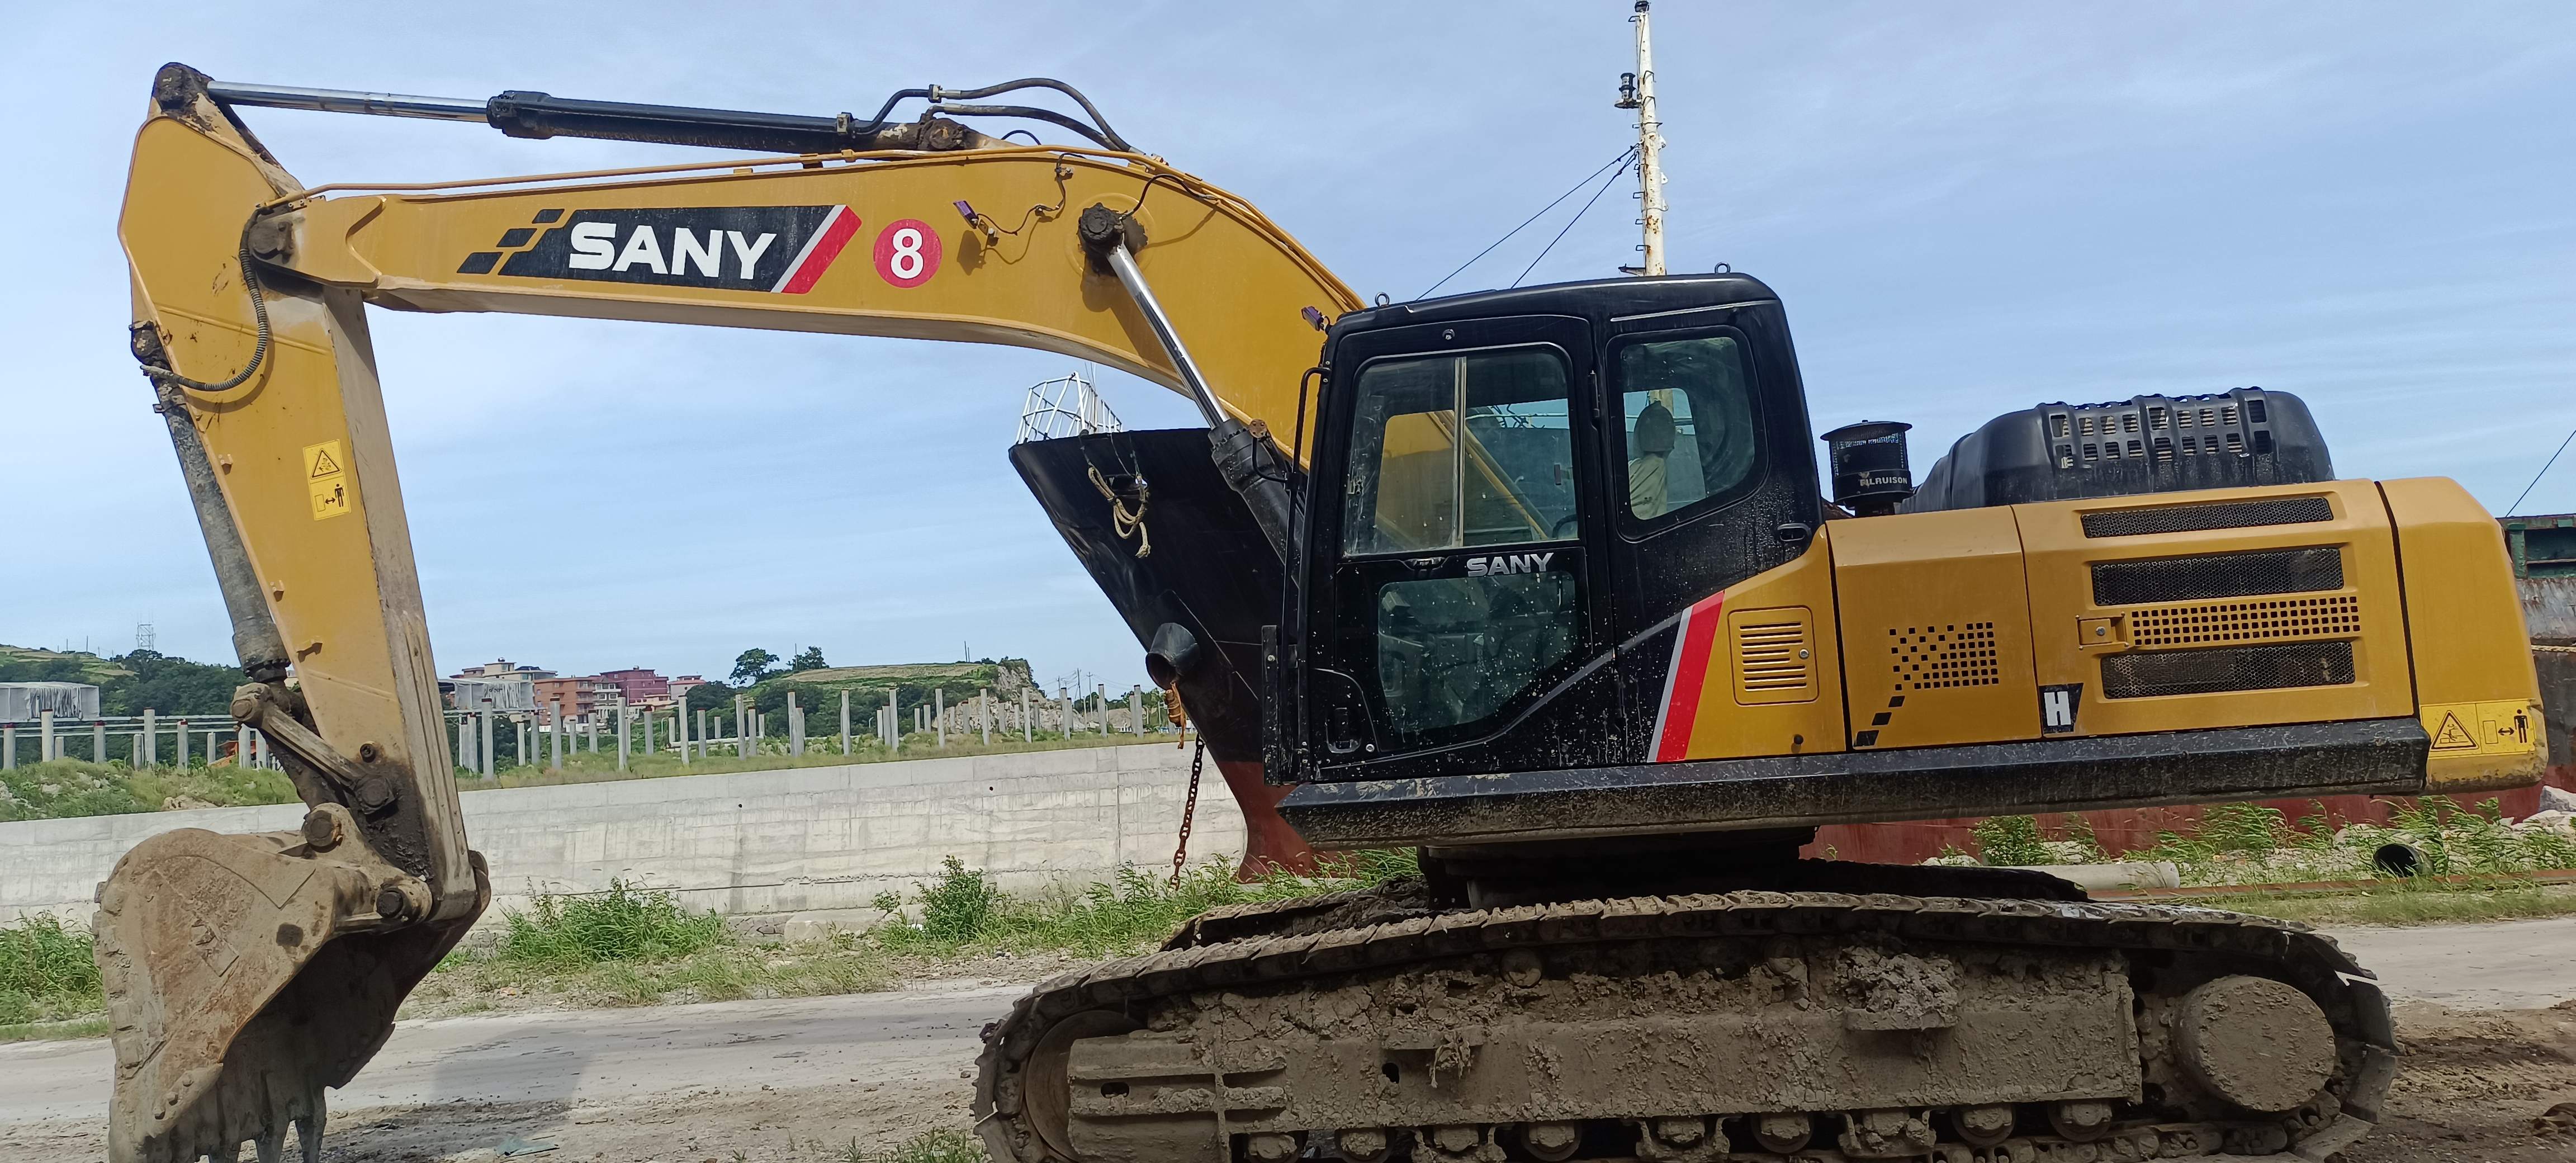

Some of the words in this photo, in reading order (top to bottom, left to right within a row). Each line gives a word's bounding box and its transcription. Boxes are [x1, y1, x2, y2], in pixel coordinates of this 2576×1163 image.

[569, 222, 776, 280] SANY
[891, 228, 924, 279] 8
[1466, 552, 1554, 577] SANY
[2044, 691, 2071, 726] H
